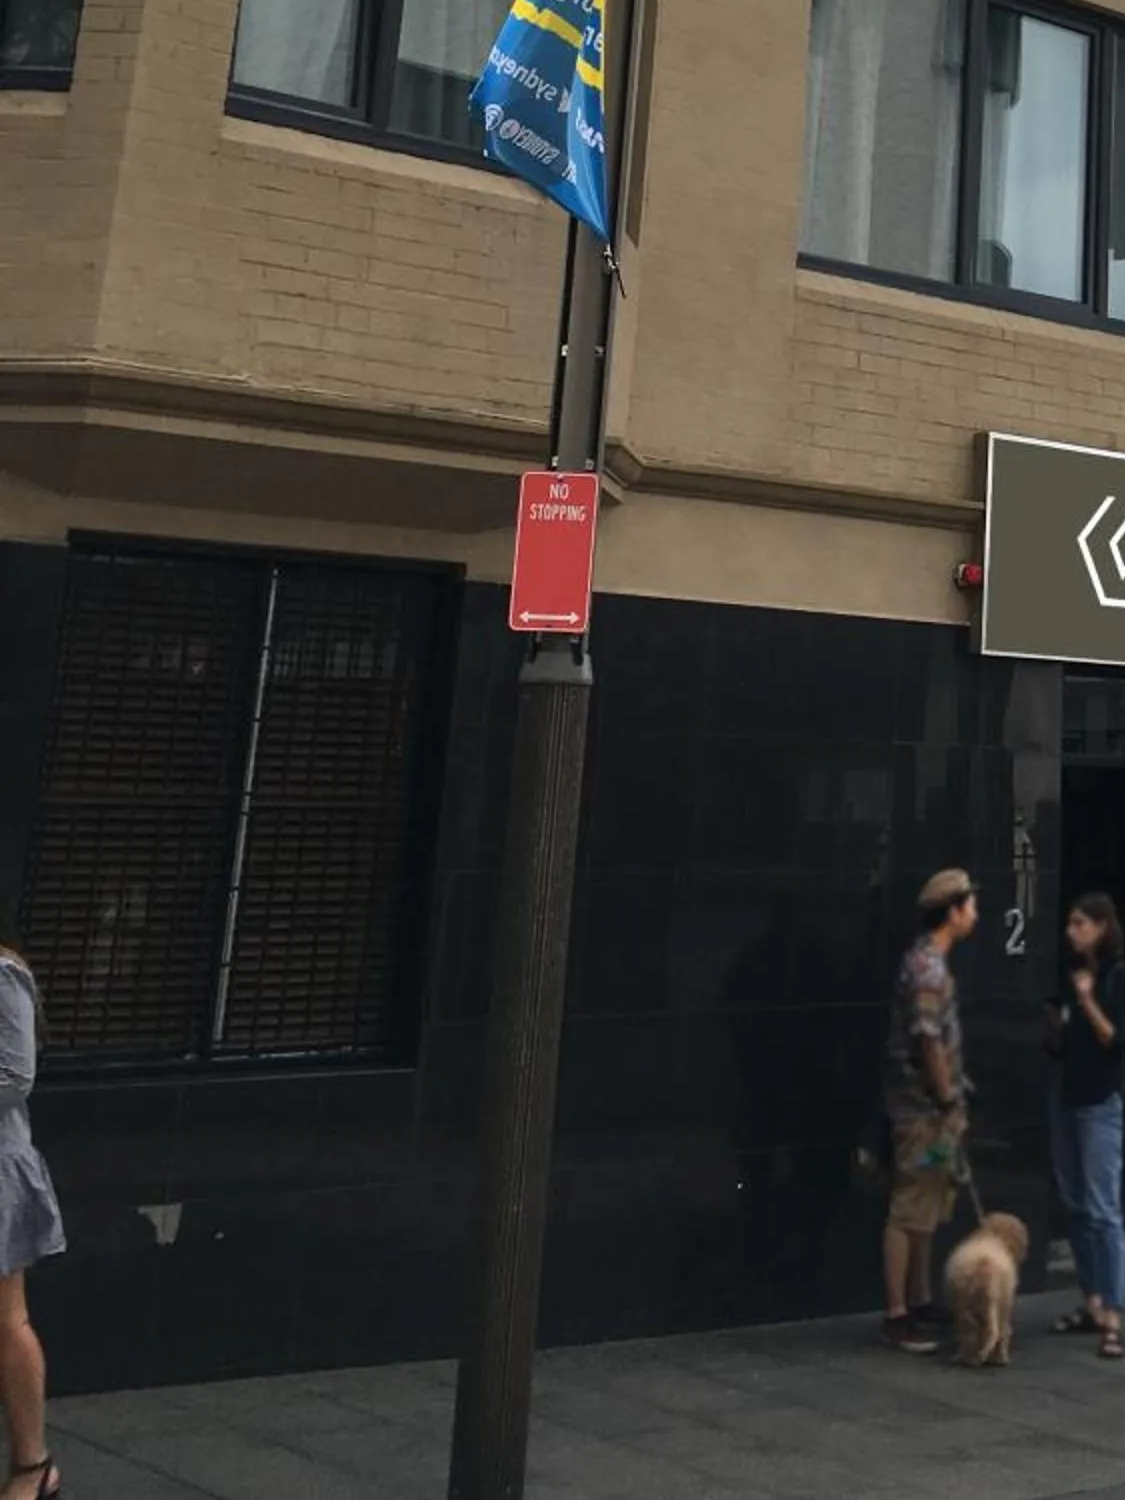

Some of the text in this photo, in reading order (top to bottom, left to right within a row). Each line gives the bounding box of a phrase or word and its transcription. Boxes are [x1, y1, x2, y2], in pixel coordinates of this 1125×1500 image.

[549, 483, 569, 500] NO
[529, 503, 586, 522] STOPPING
[1003, 907, 1026, 956] 2
